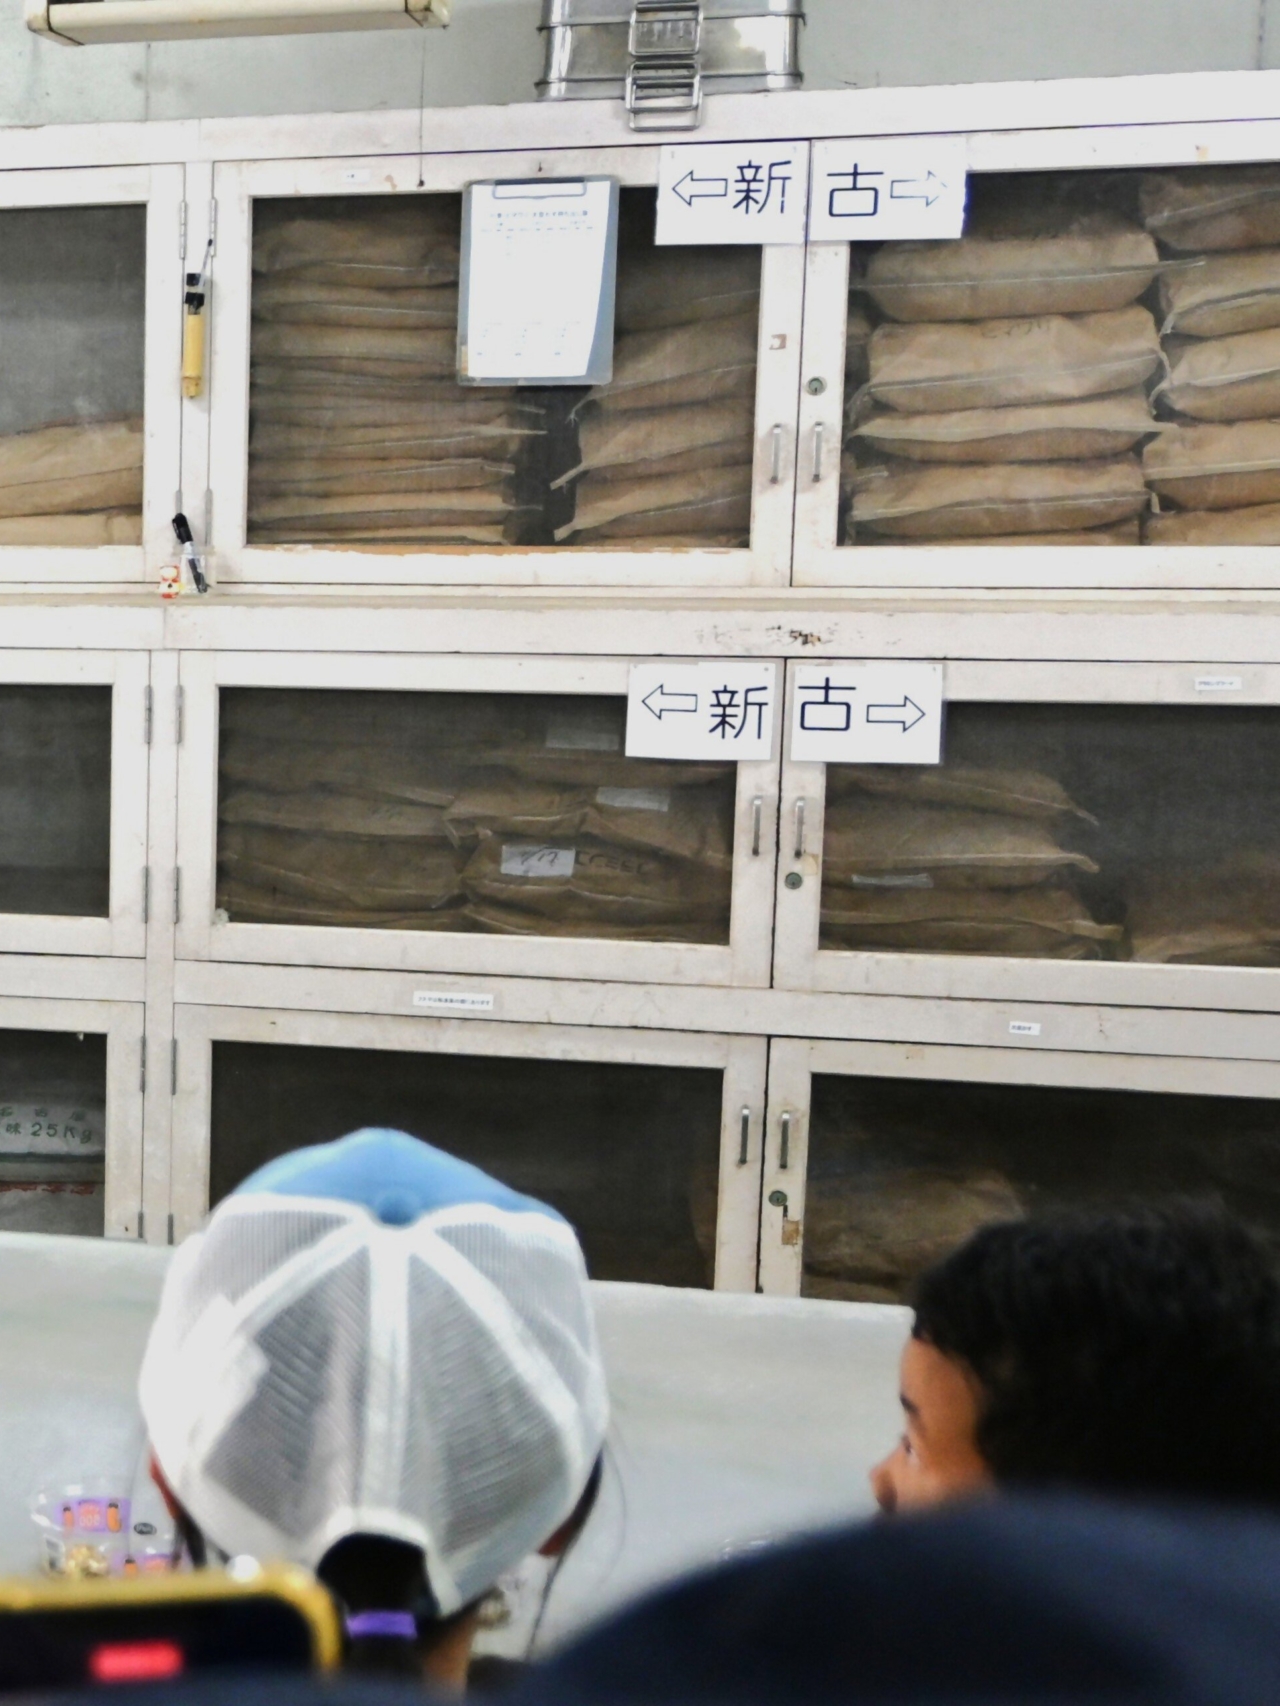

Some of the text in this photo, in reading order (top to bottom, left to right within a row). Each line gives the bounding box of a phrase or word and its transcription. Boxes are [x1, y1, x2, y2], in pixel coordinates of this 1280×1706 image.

[733, 160, 792, 215] 新
[826, 162, 884, 217] 古
[708, 684, 769, 740] 新
[797, 676, 857, 732] 古
